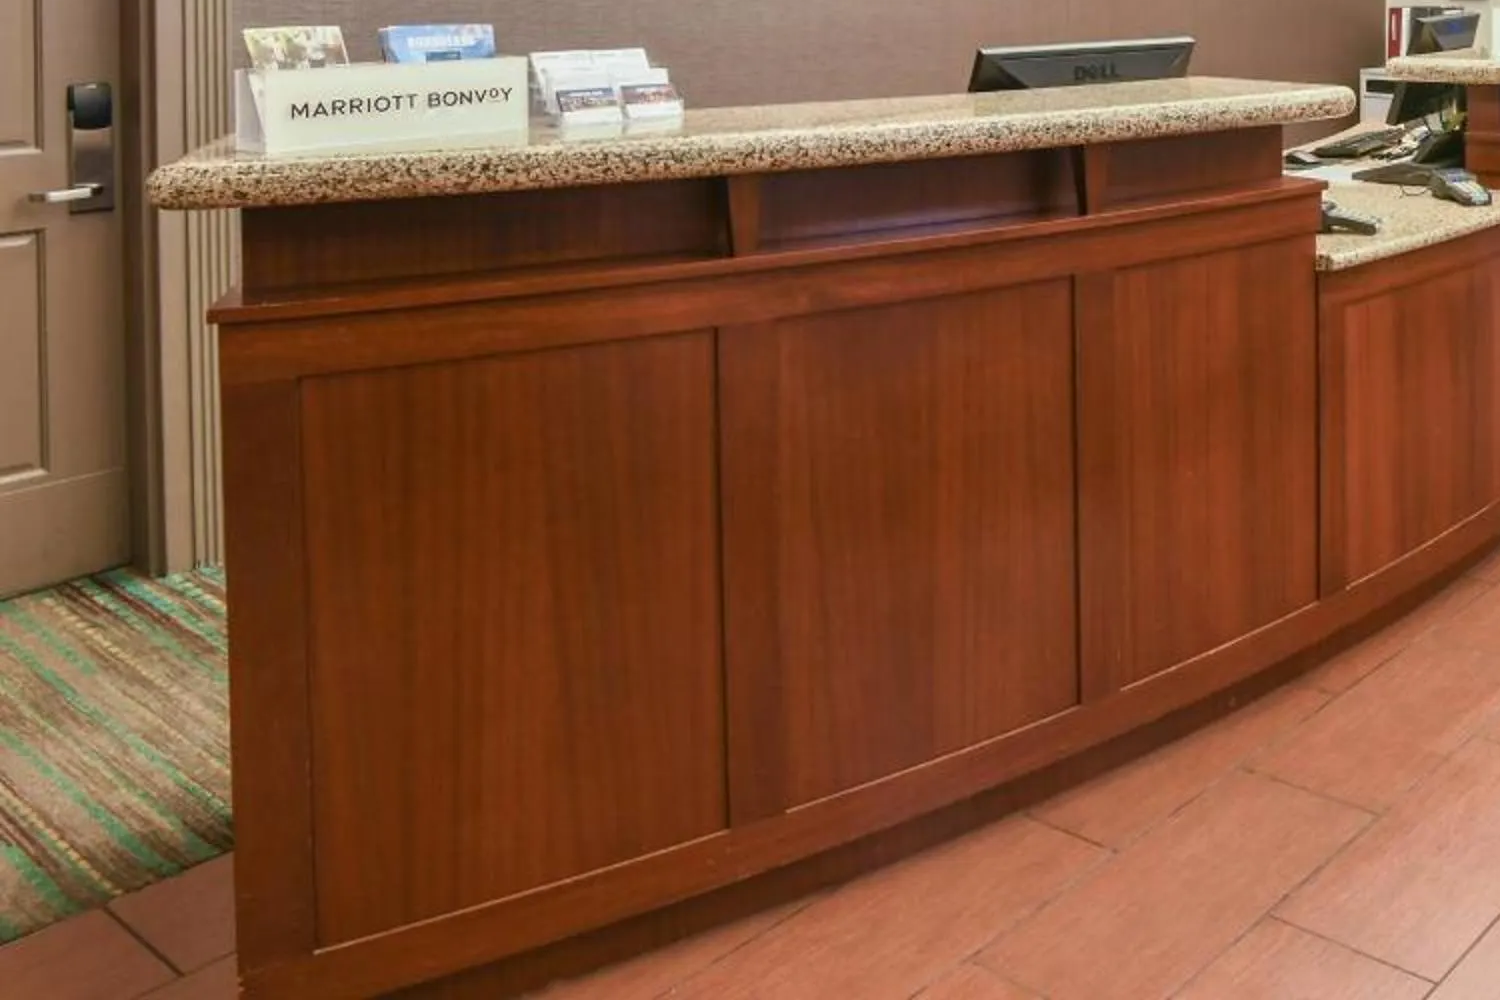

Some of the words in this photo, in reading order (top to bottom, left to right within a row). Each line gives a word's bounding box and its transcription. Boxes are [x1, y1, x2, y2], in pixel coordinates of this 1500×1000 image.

[1073, 62, 1119, 81] DELL
[290, 93, 418, 120] MARRIOTT
[427, 87, 513, 109] BONVOY
